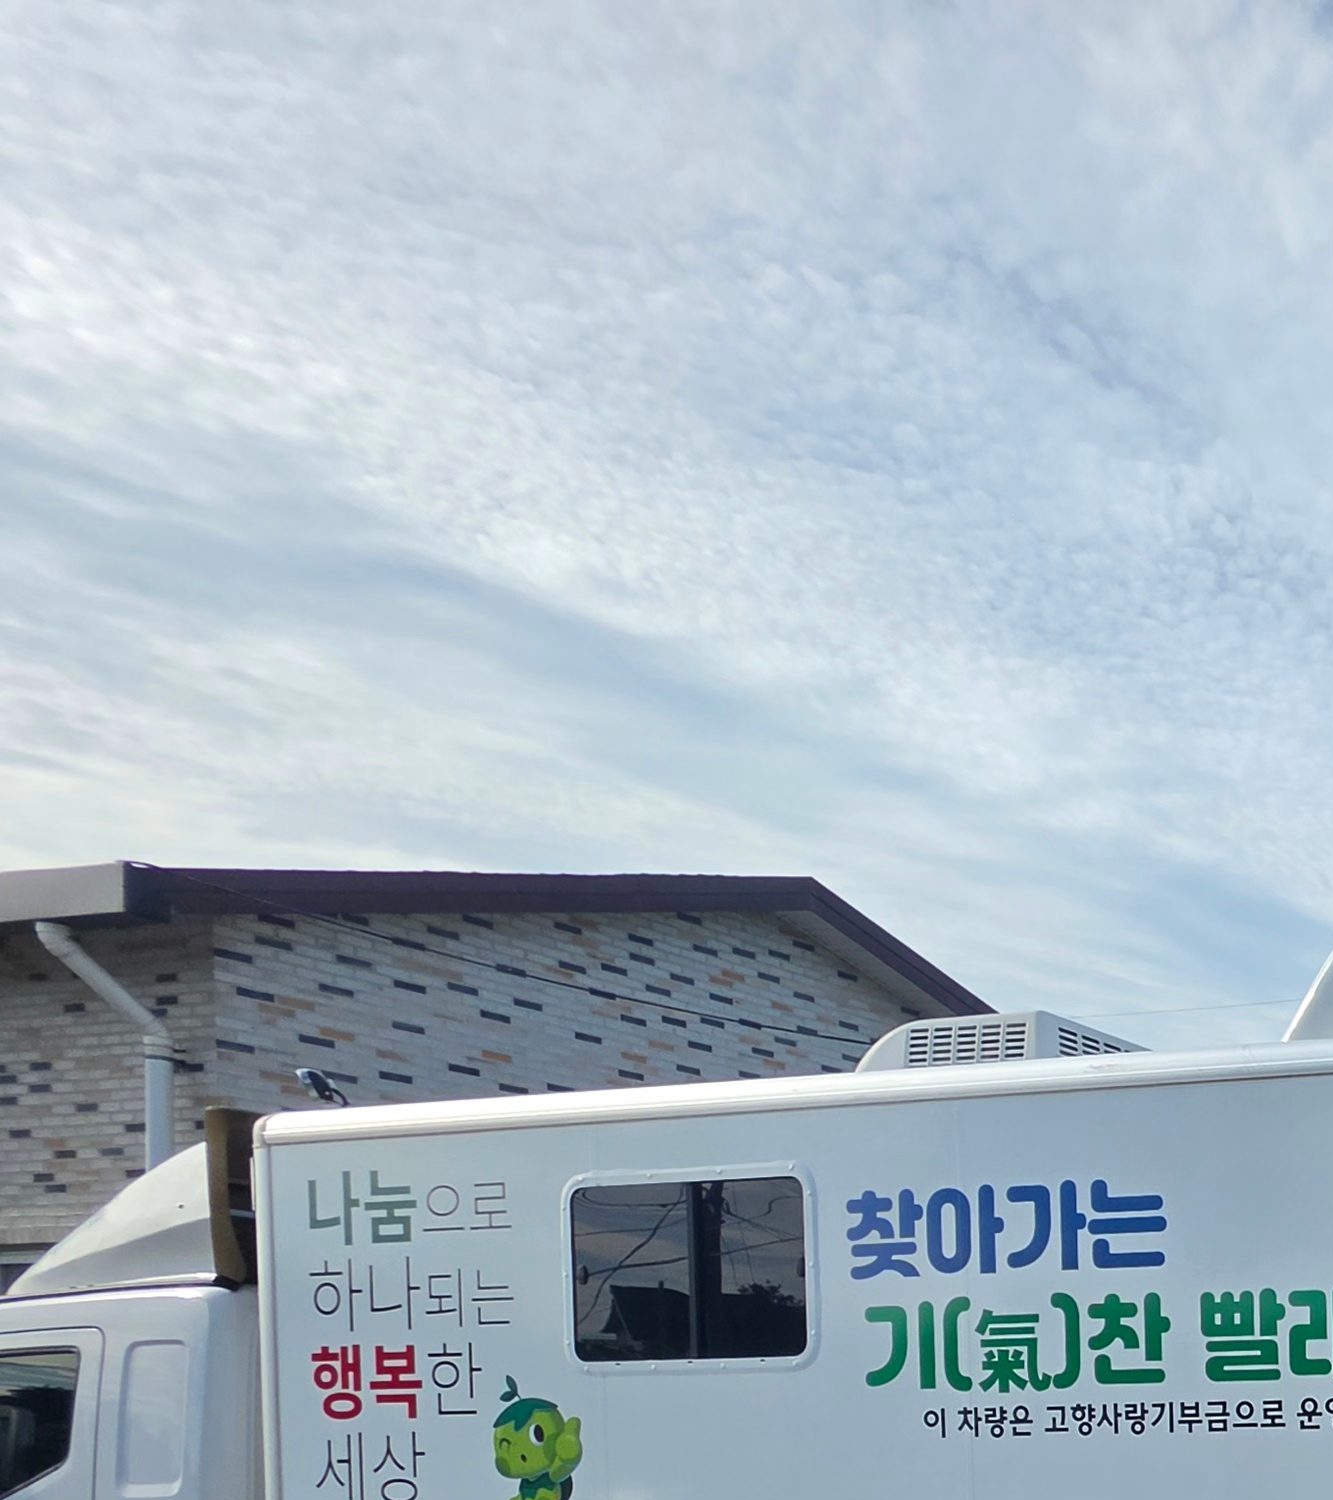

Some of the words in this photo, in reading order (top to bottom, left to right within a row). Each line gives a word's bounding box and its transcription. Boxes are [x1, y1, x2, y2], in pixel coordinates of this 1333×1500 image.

[308, 1170, 512, 1246] 나눔으로
[846, 1179, 1167, 1281] 찾아가는
[309, 1256, 514, 1331] 하나되는
[311, 1342, 482, 1420] 행복한
[864, 1292, 1170, 1394] 기(氣)찬
[923, 1408, 948, 1438] 이
[957, 1405, 1034, 1437] 차량은
[1044, 1399, 1287, 1436] 고향사랑기부금으로
